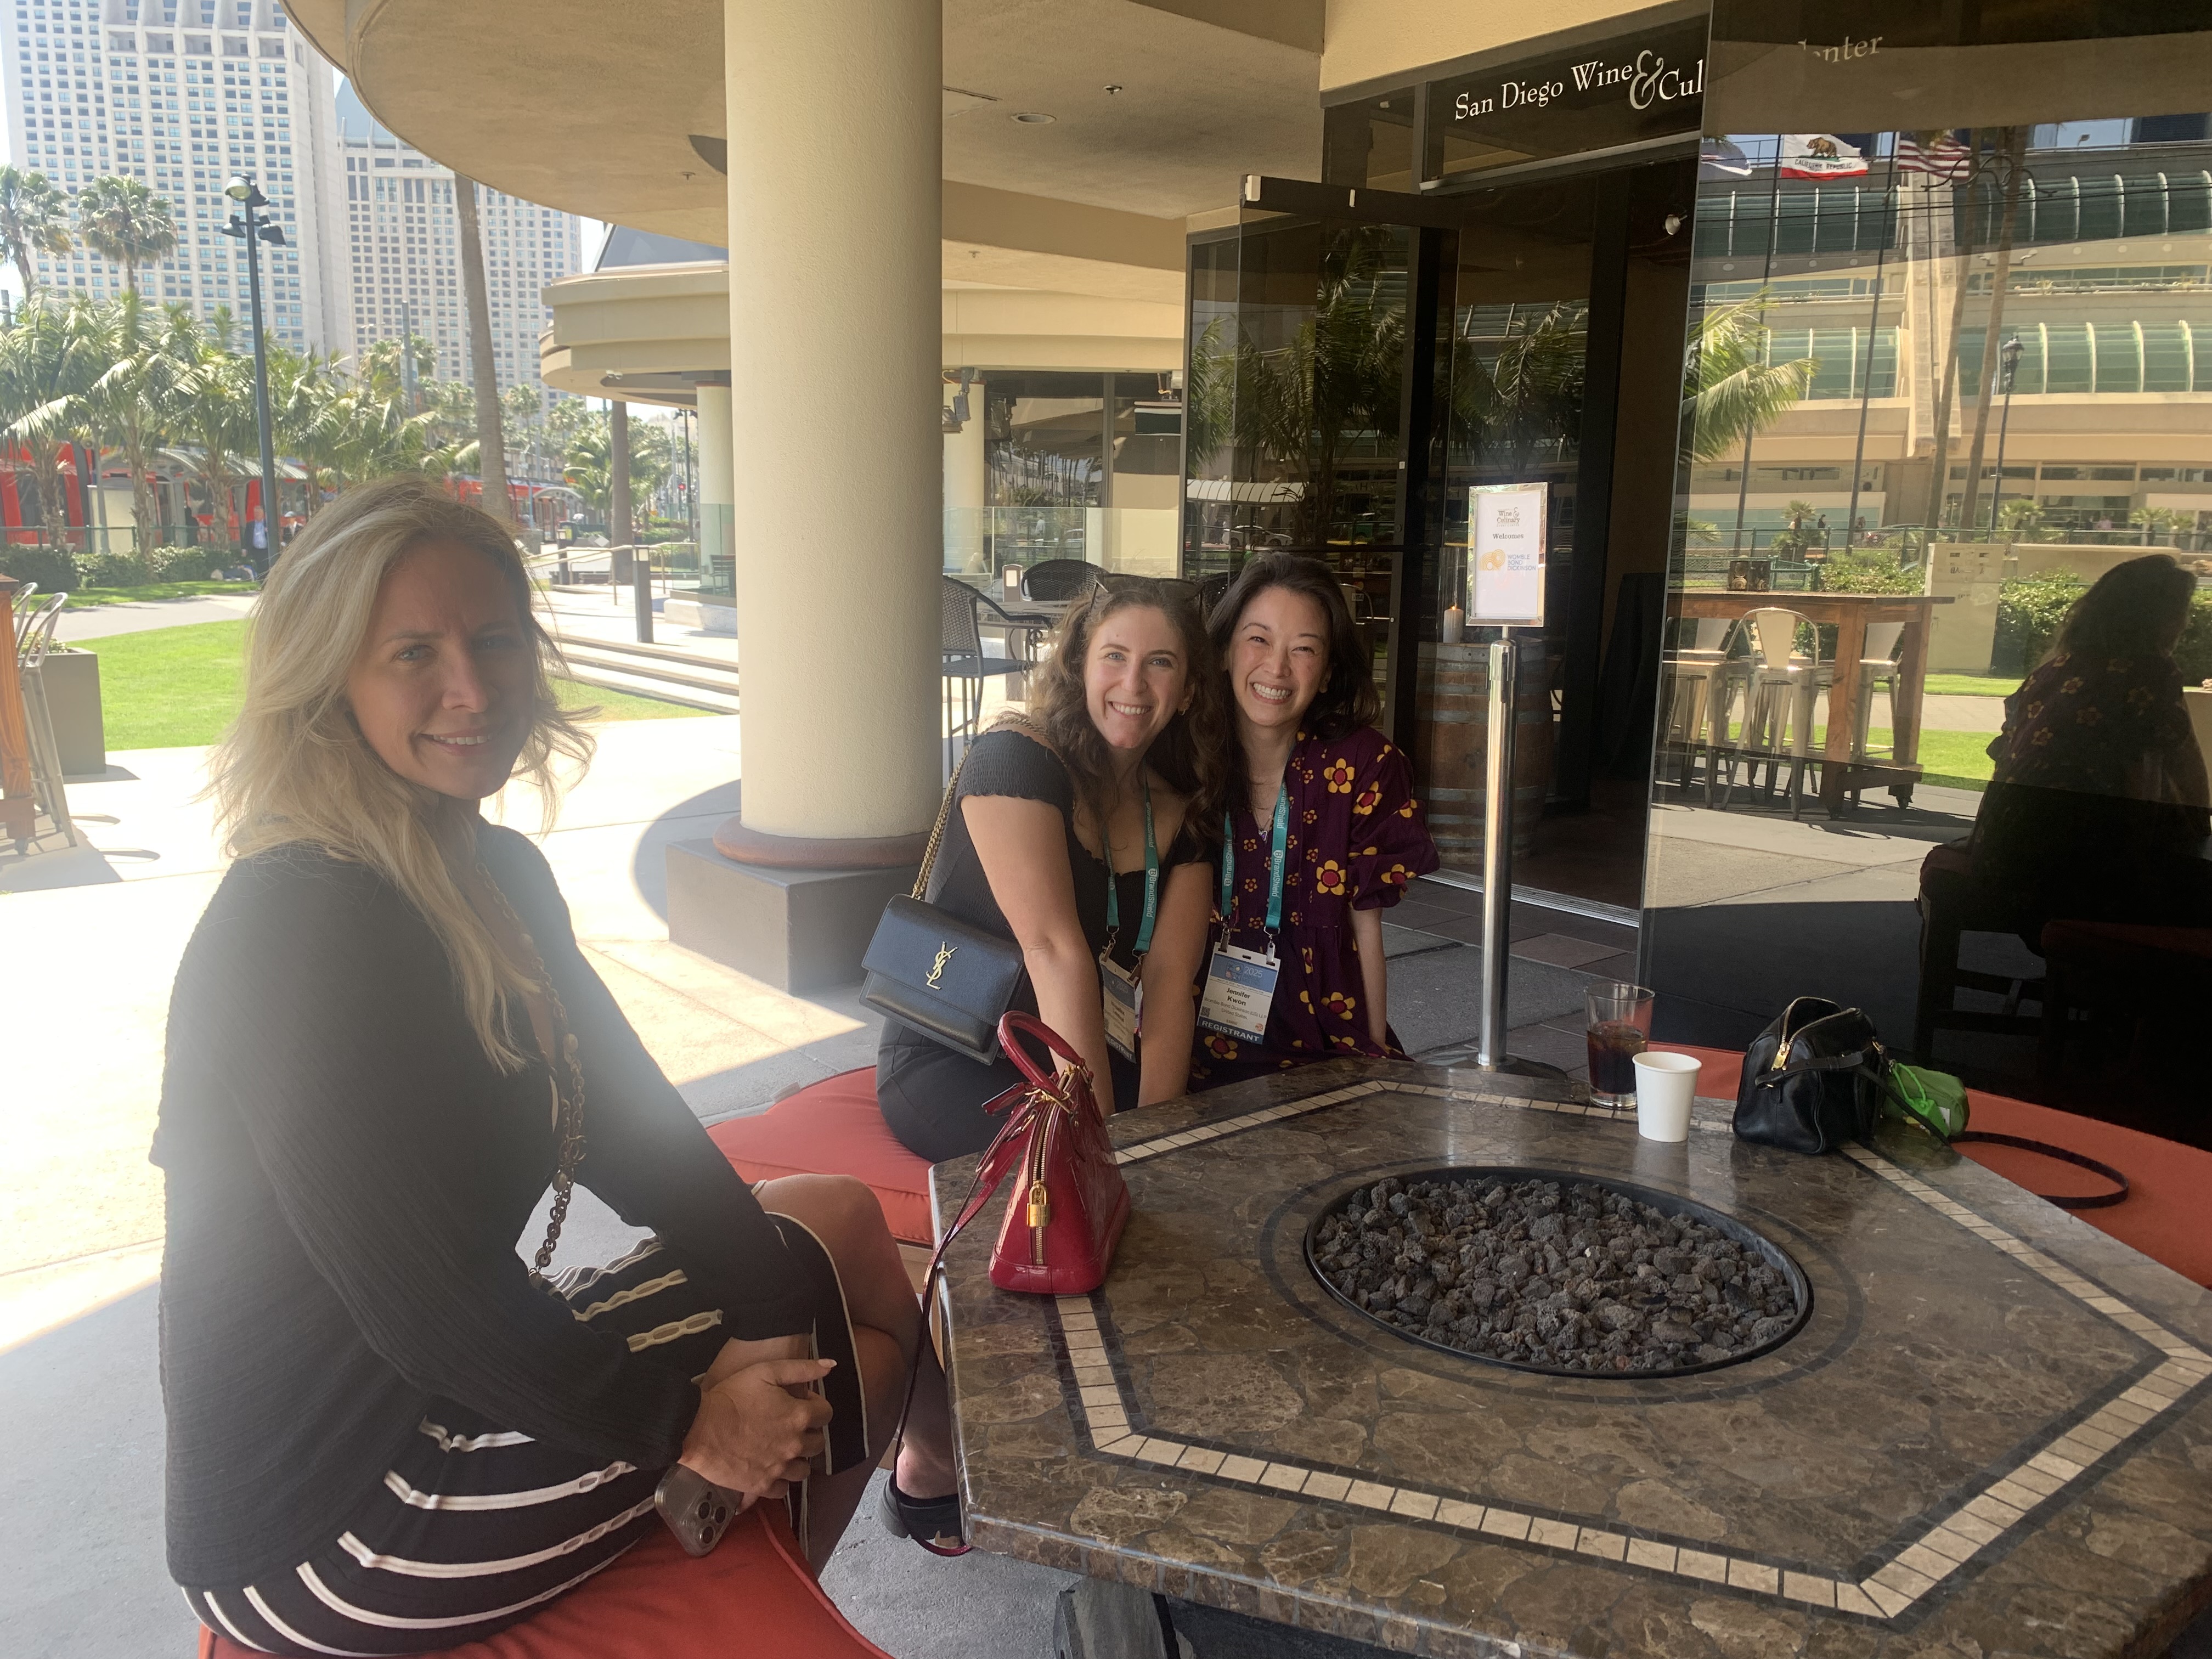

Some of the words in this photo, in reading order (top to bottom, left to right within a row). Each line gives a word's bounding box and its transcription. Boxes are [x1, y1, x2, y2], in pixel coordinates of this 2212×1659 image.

[1455, 92, 1493, 120] San
[1502, 81, 1564, 107] Diego
[1571, 60, 1633, 92] Wine
[1629, 49, 1664, 110] &
[1798, 36, 1883, 63] nter
[1272, 858, 1282, 897] BrandShield
[1146, 876, 1157, 918] BrandShield
[1244, 966, 1263, 978] 2025
[1226, 988, 1250, 998] Jennifer
[1227, 996, 1246, 1006] Kwon
[1202, 1020, 1260, 1042] REGISTRANT
